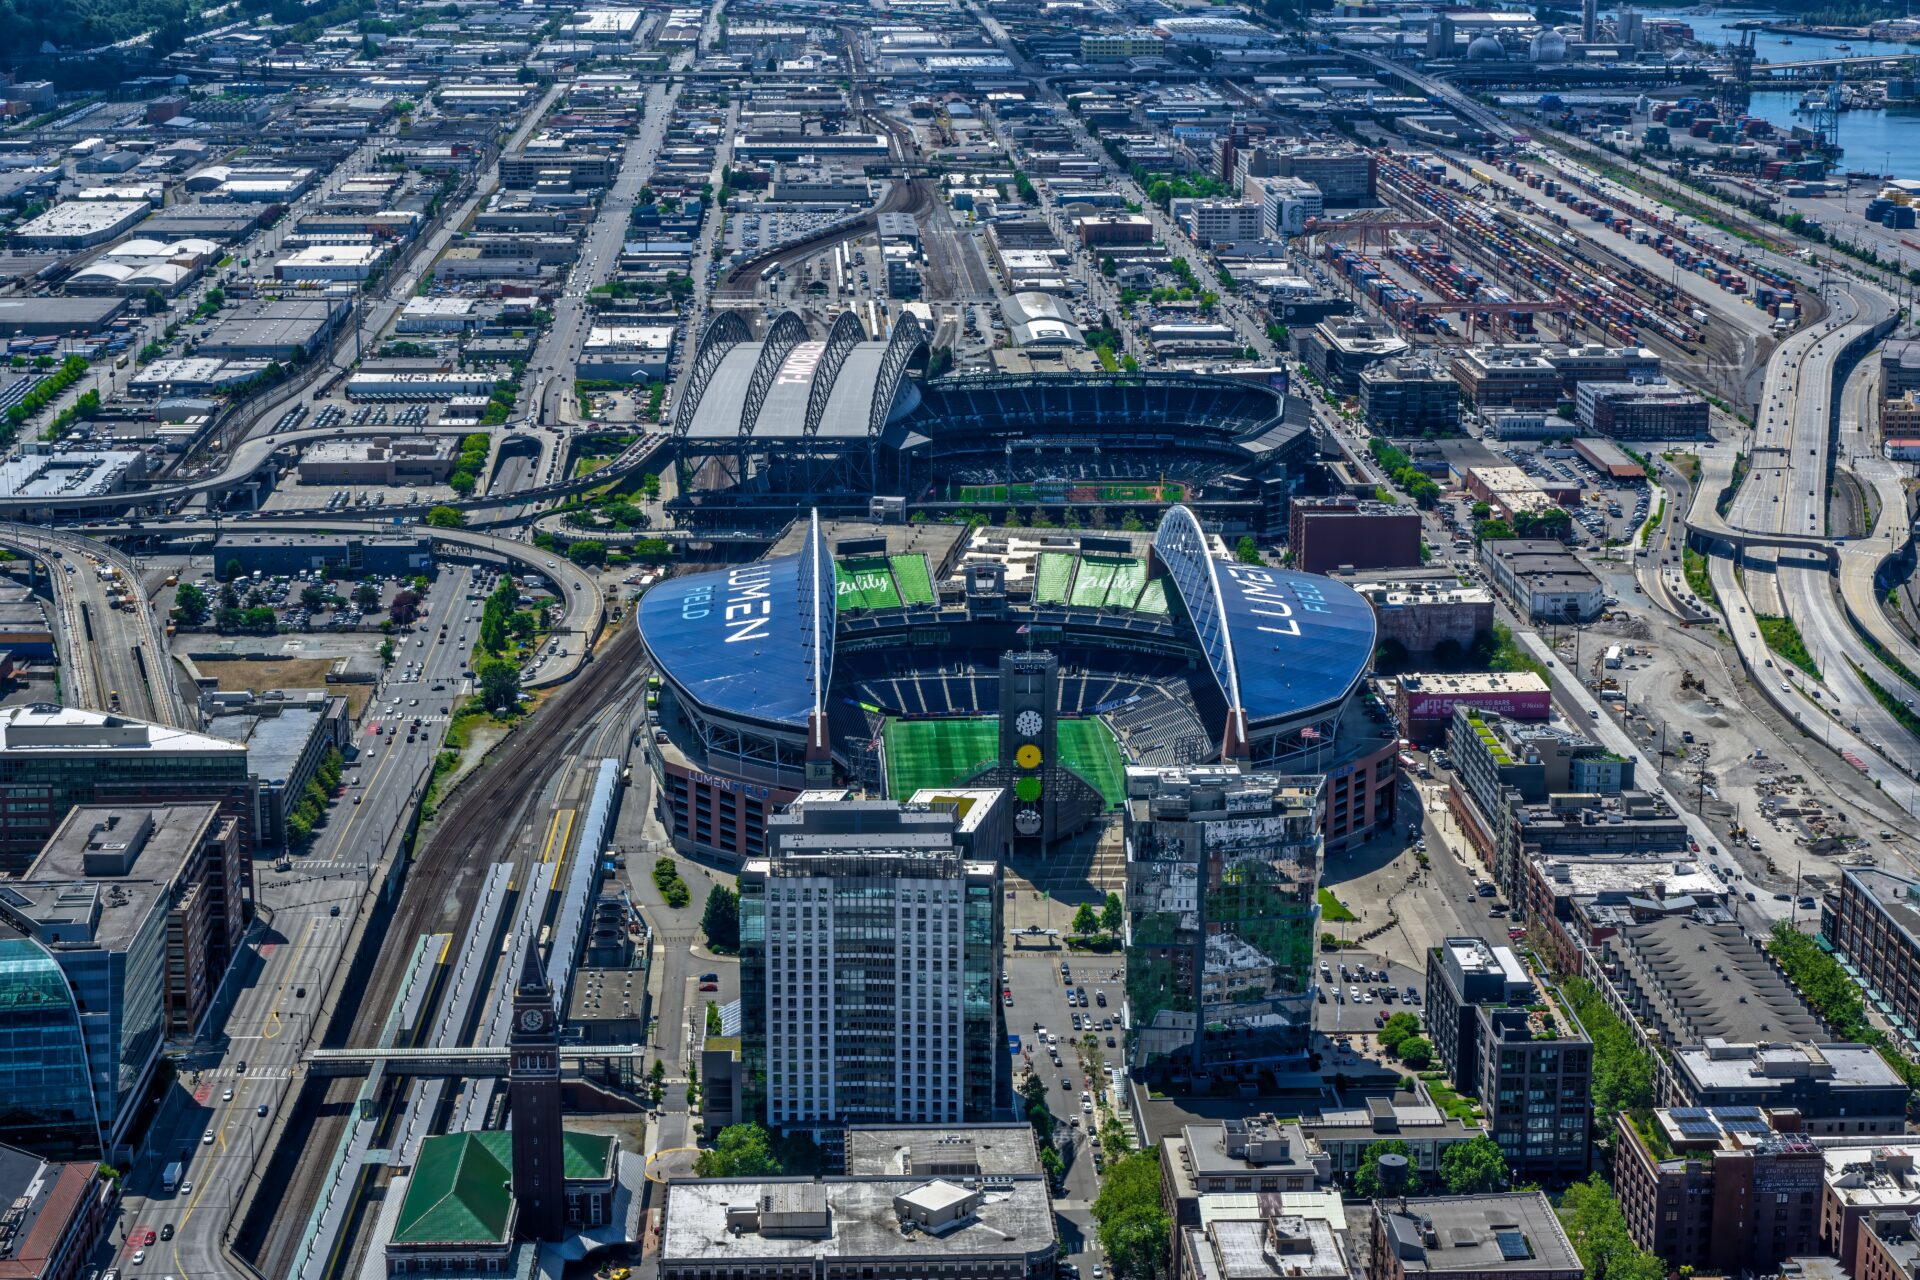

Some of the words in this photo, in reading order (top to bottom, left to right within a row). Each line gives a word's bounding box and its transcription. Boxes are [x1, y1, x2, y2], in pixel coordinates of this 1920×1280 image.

[778, 341, 826, 385] T-MOBILE
[836, 573, 889, 595] zulily
[1289, 581, 1333, 614] FIELD
[682, 586, 712, 620] FIELD
[724, 564, 772, 643] LUMEN
[688, 770, 731, 790] LUMEN
[732, 782, 769, 798] FIELD
